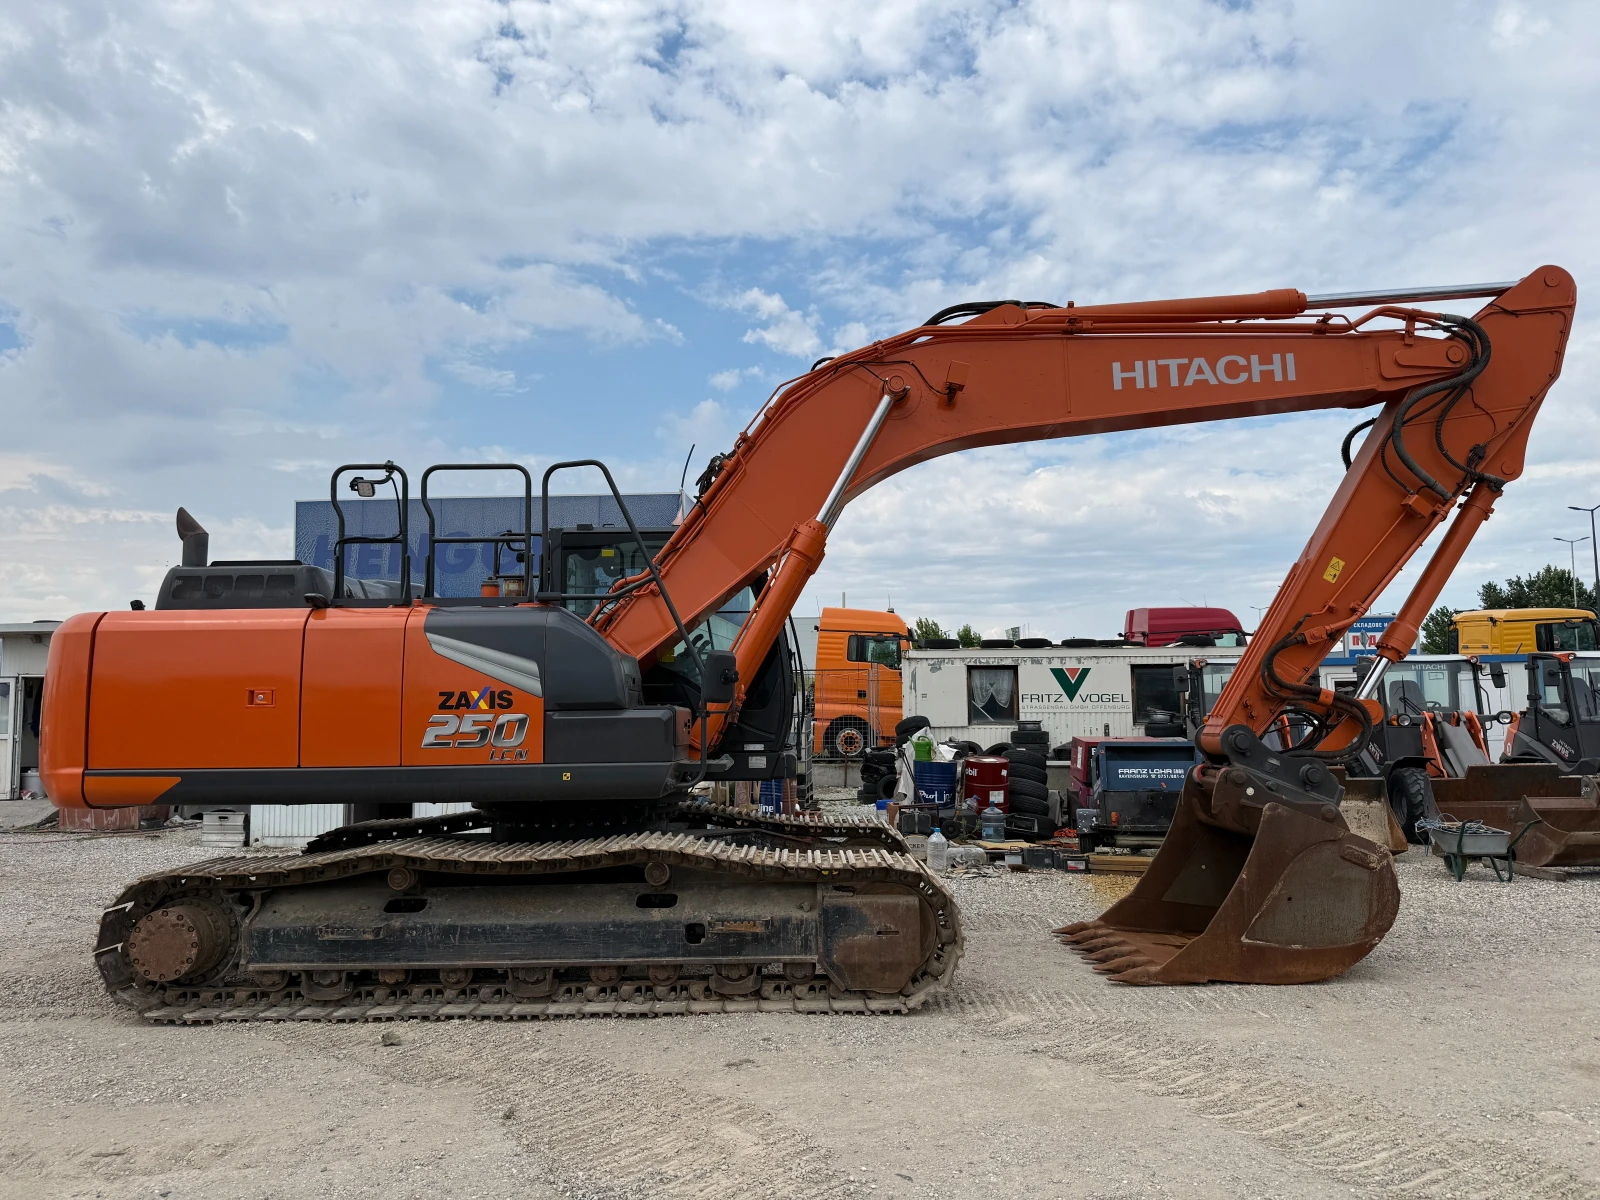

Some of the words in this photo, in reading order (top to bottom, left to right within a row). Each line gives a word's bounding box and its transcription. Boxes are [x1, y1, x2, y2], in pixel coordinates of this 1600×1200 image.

[1112, 353, 1296, 390] HITACHI
[1352, 634, 1377, 647] ПД
[438, 686, 514, 710] ZAXIS
[1021, 693, 1064, 703] FRITZ
[1079, 693, 1130, 703] VOGEL
[421, 713, 530, 749] 250
[489, 748, 529, 761] LCN
[965, 768, 978, 777] obil
